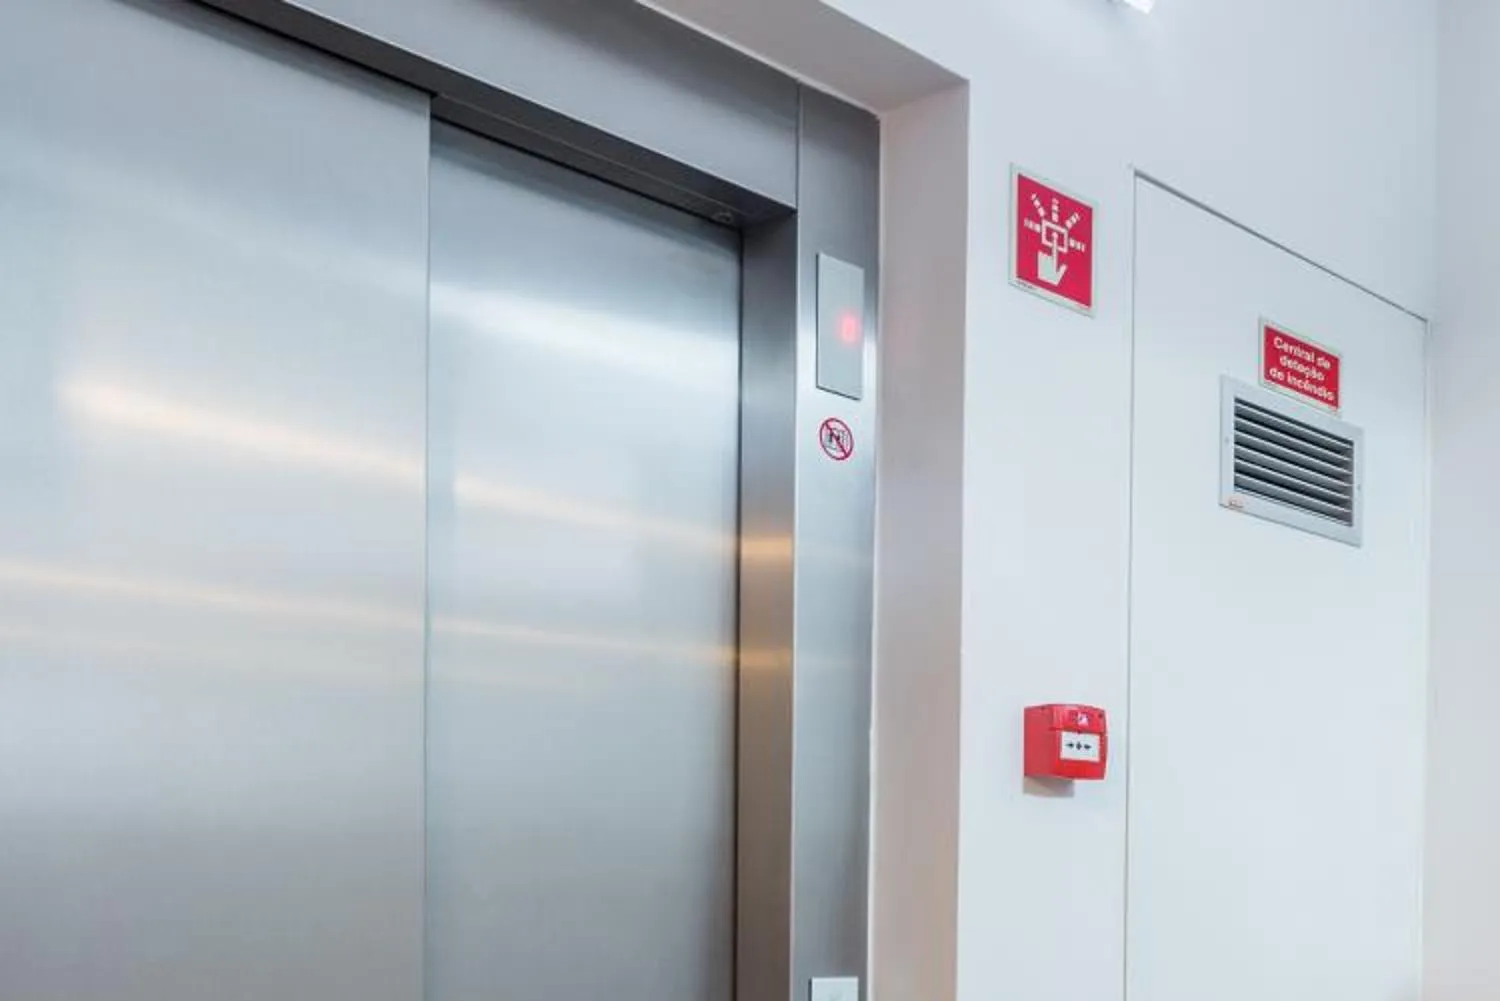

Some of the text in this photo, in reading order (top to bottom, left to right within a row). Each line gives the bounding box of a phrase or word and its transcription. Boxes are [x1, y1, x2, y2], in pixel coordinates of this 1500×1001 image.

[1273, 335, 1331, 369] Central de
[1269, 367, 1335, 401] de incêndio
